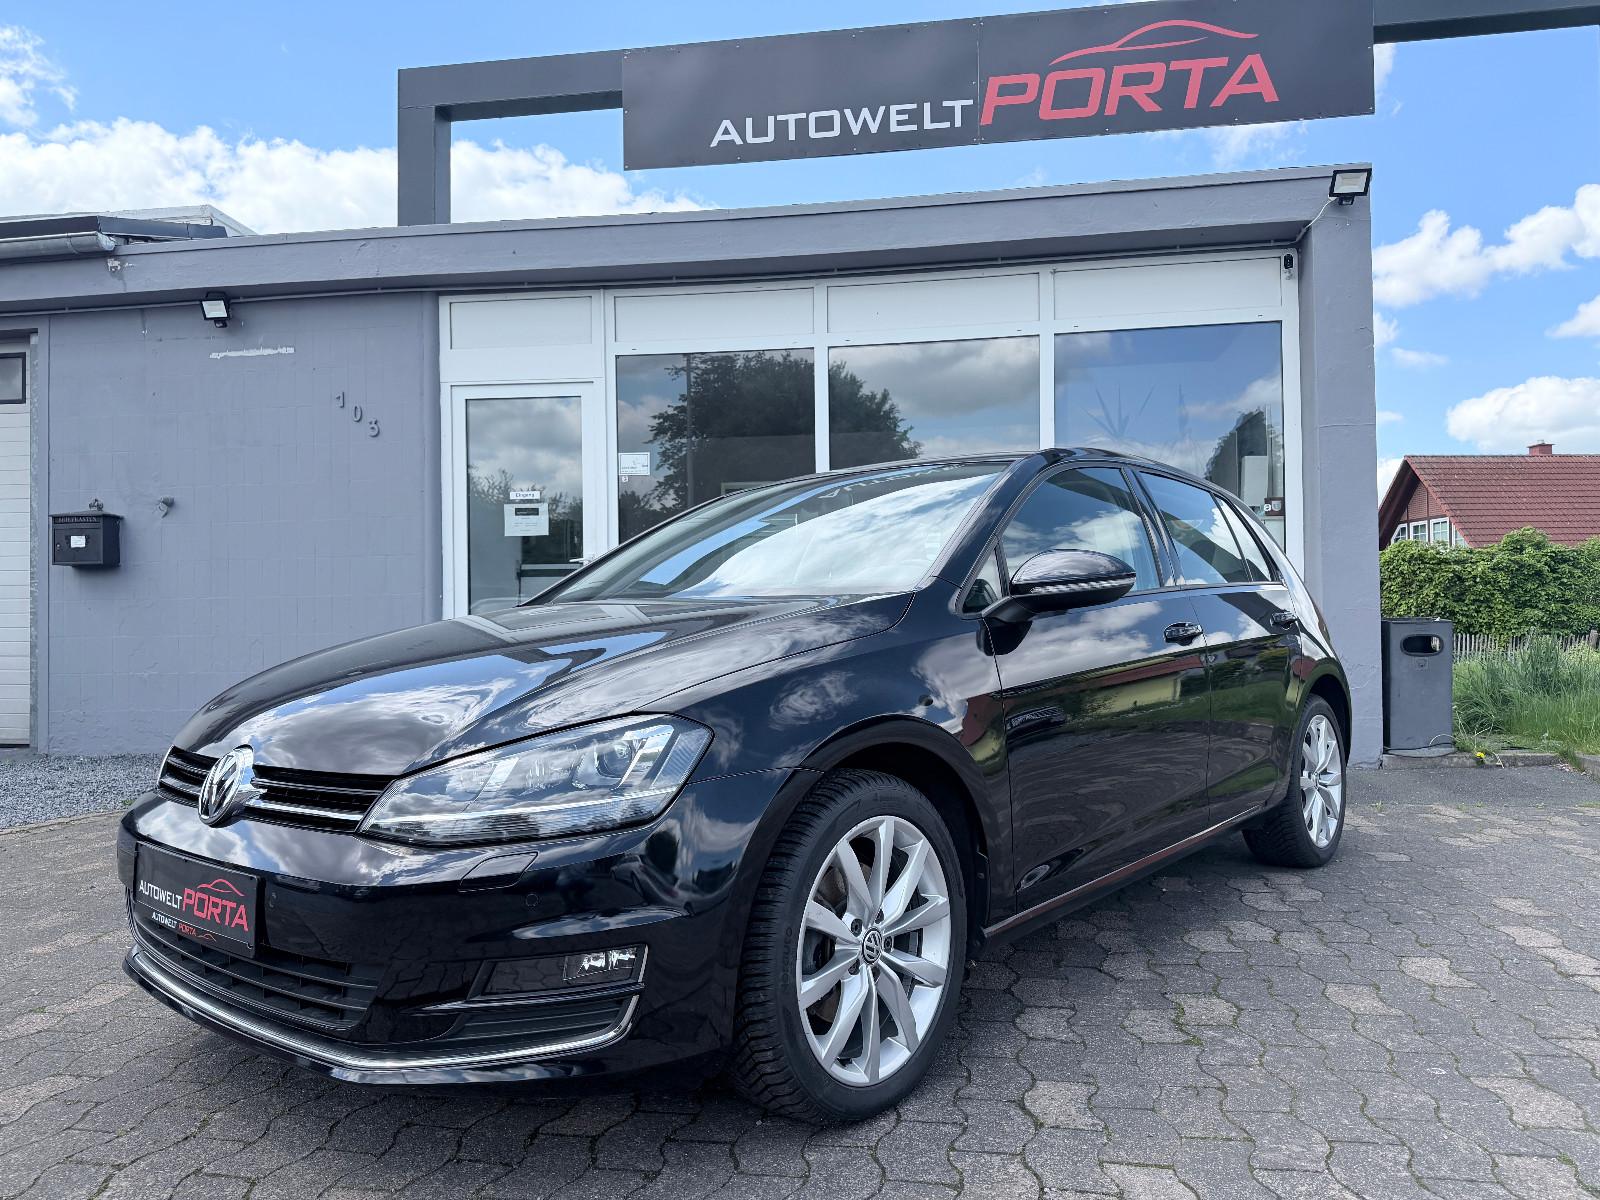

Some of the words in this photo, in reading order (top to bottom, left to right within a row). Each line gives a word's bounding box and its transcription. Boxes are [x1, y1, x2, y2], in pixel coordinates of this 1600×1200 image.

[710, 99, 974, 147] AUTOWELT
[979, 53, 1279, 126] PORTA
[138, 879, 182, 910] AUTOWELT
[182, 887, 249, 932] PORTA
[151, 911, 178, 929] AUTOWELT
[178, 922, 197, 936] PORTA
